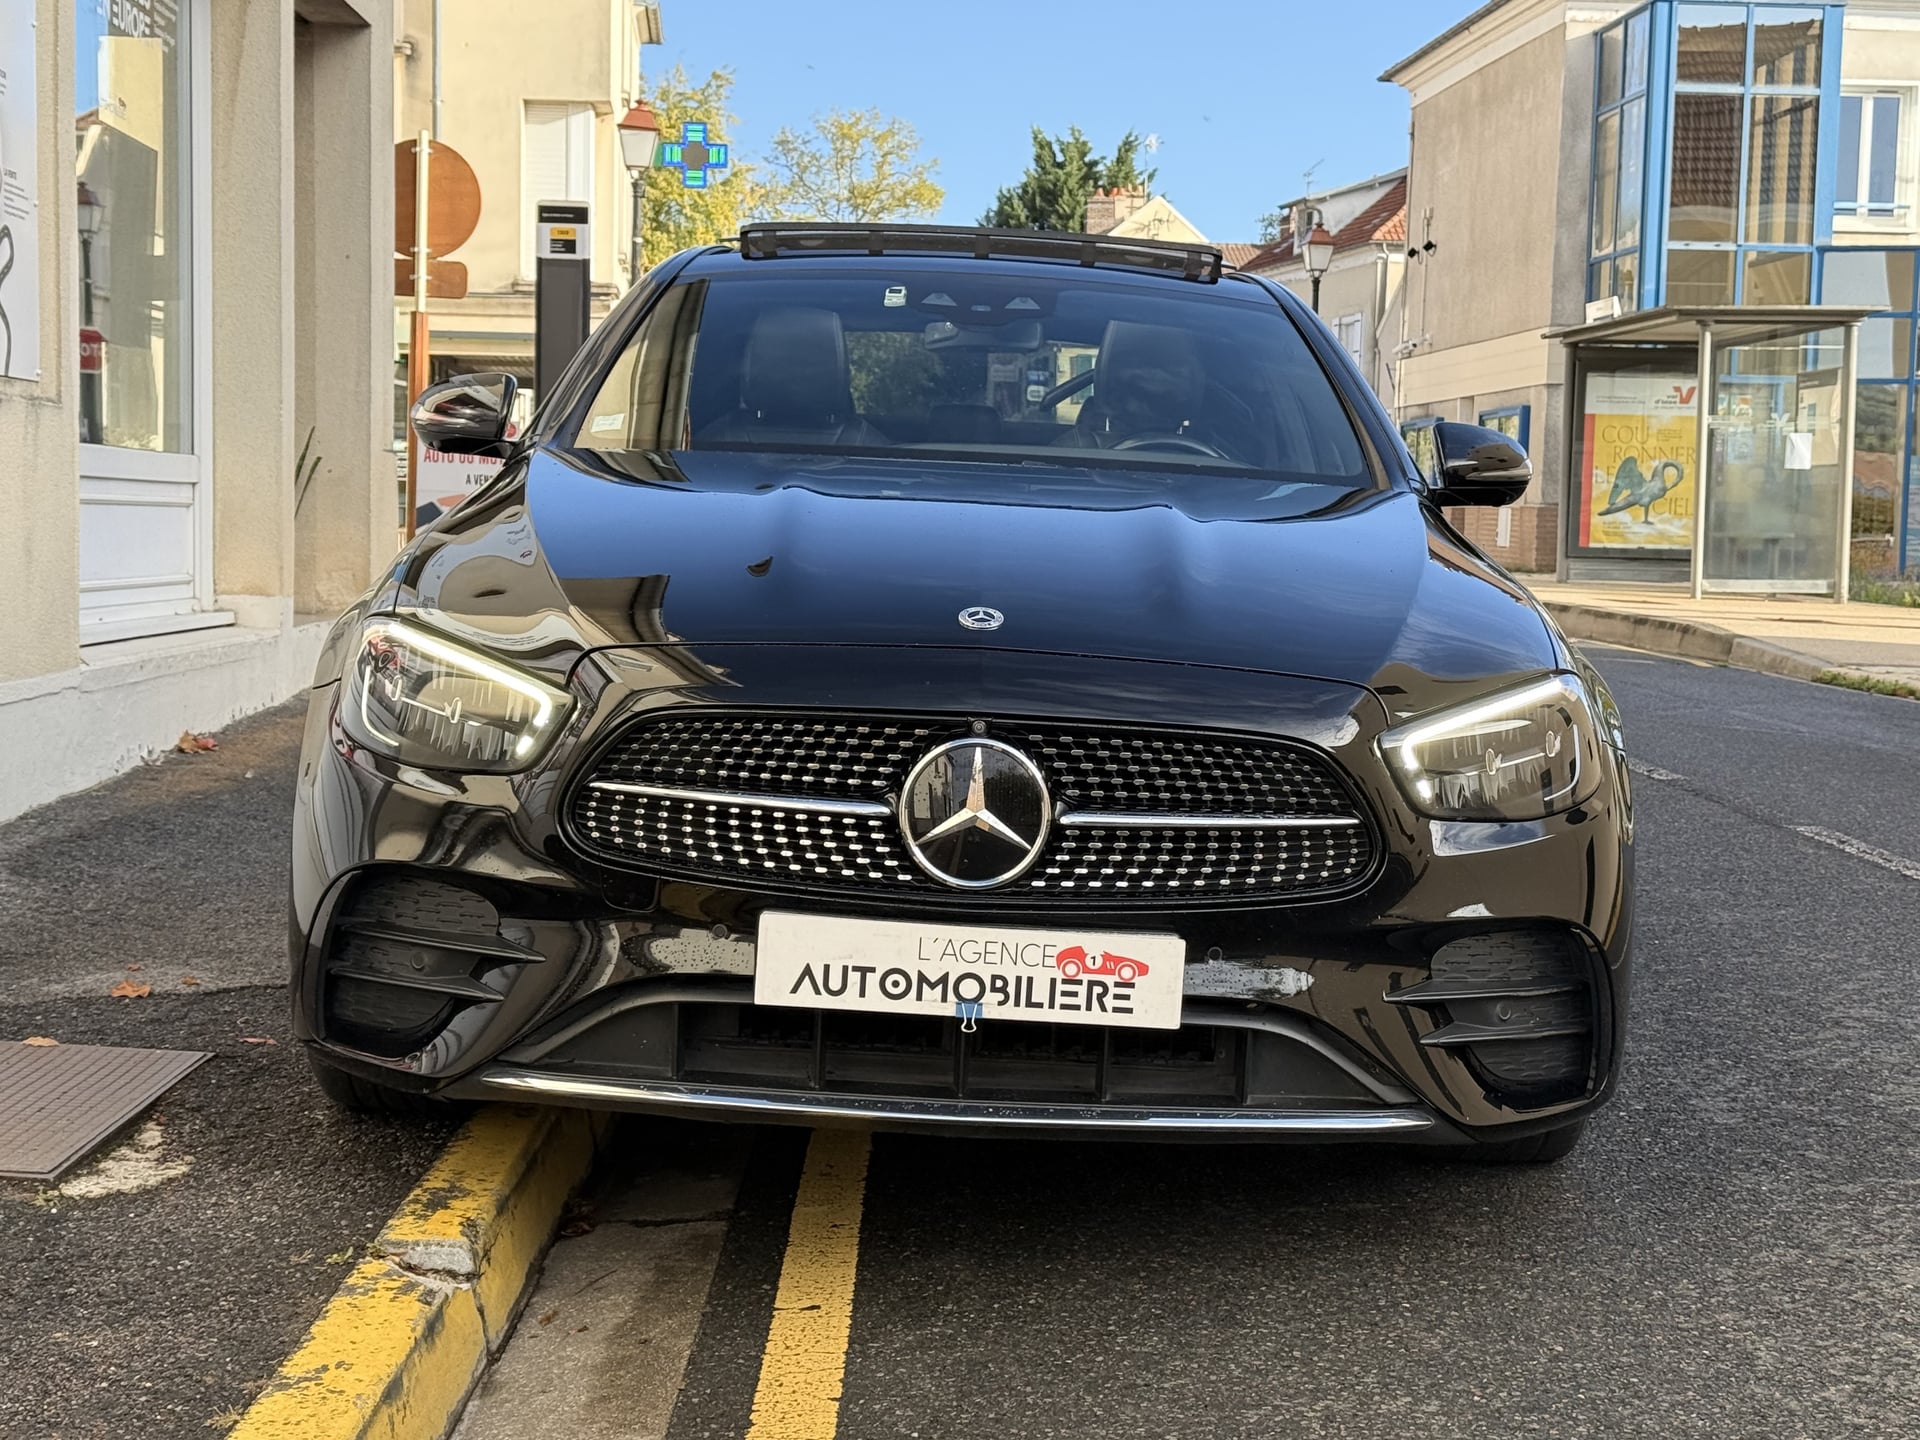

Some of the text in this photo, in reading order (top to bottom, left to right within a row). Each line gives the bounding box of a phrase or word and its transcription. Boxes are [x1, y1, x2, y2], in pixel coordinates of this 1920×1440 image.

[1602, 424, 1649, 444] COU
[1613, 445, 1696, 464] RONNER
[465, 473, 471, 485] A
[1595, 465, 1616, 484] LE
[1652, 496, 1694, 516] CIEL
